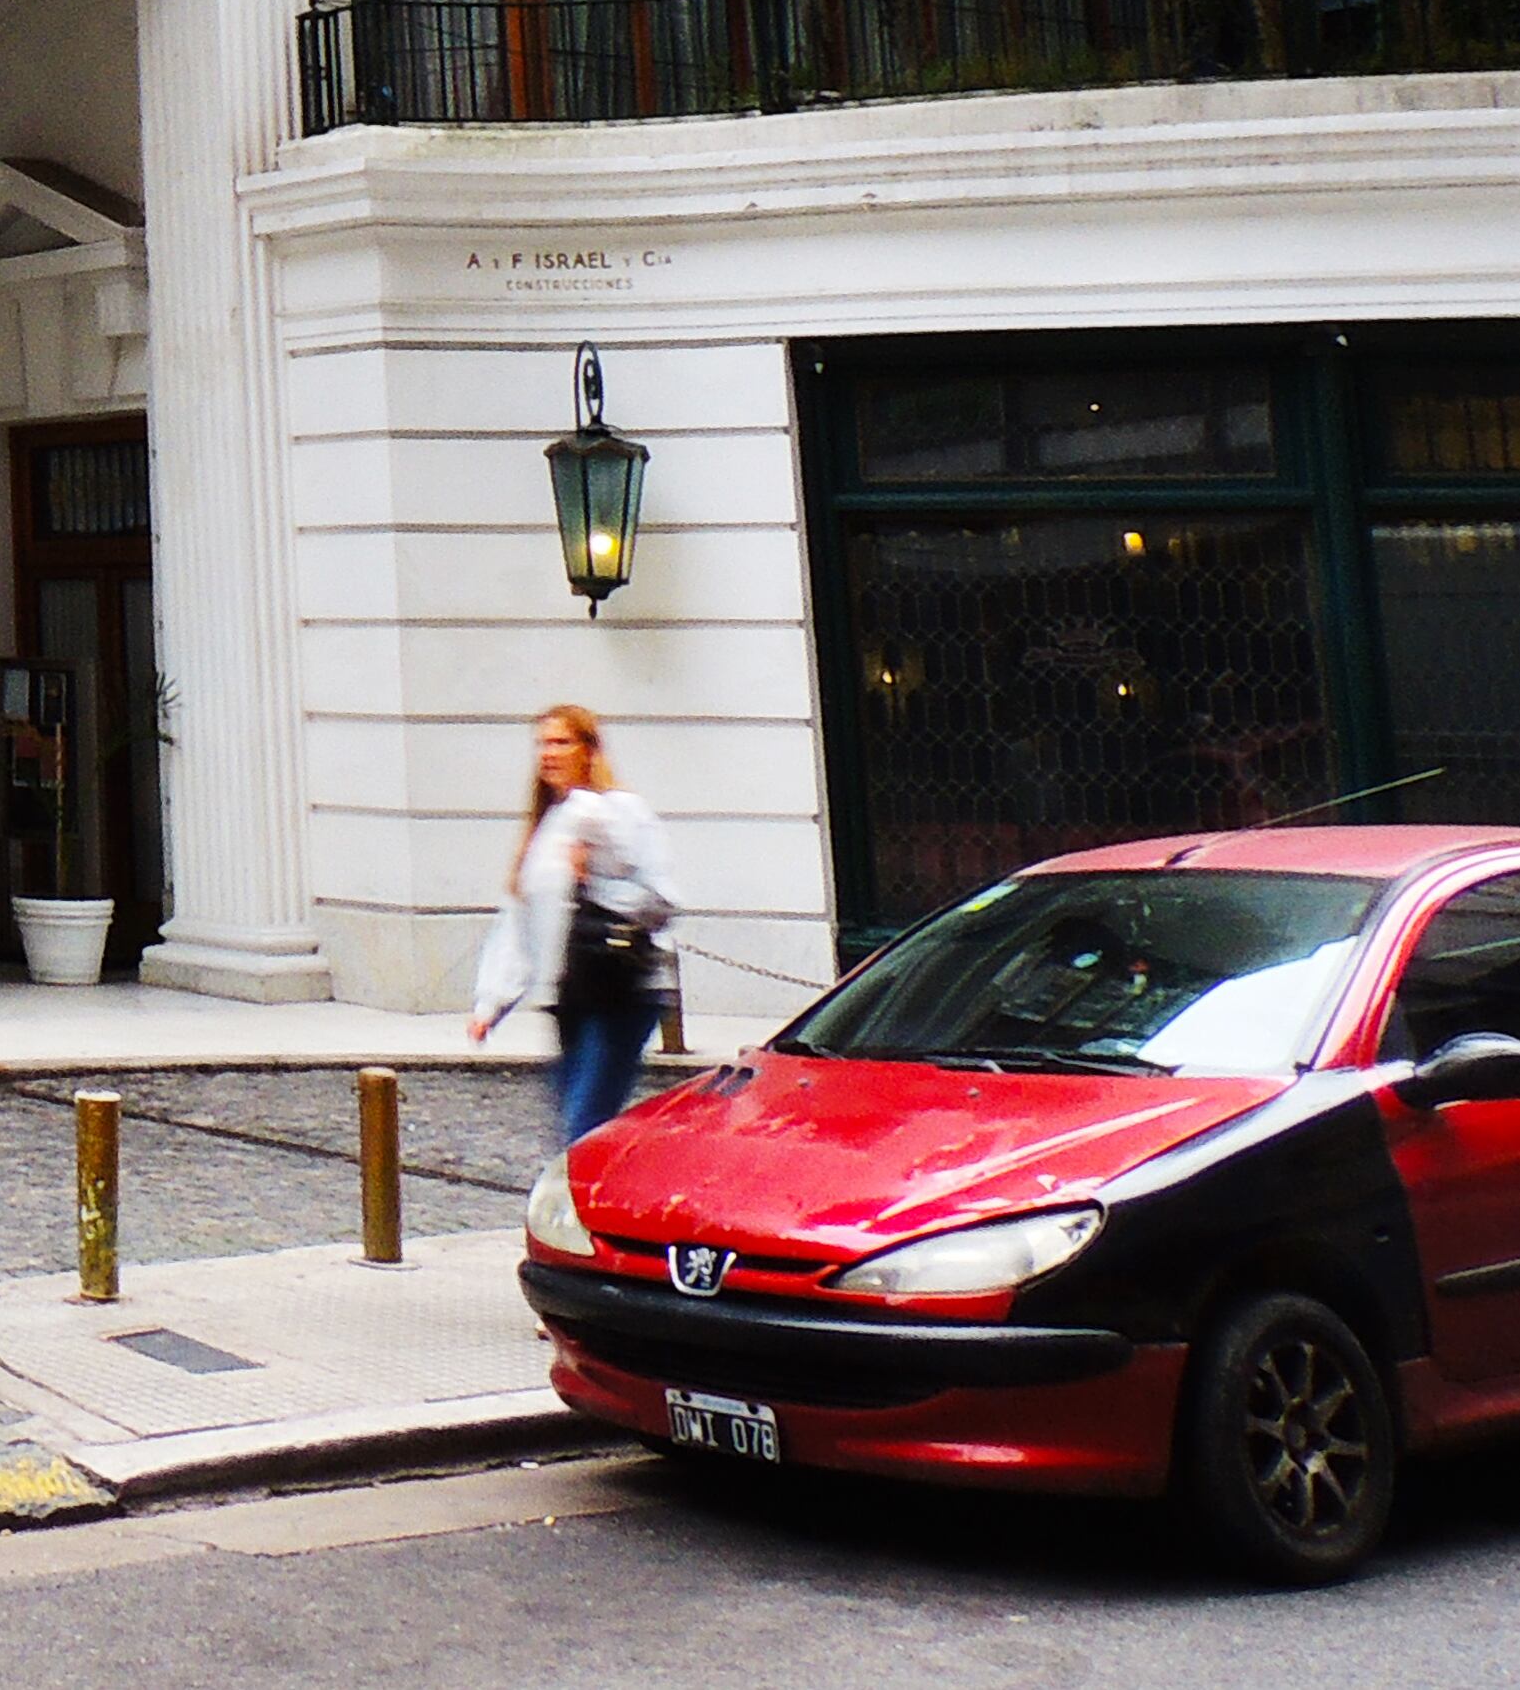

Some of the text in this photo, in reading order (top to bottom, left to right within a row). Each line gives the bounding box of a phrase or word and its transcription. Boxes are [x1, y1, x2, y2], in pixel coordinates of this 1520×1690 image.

[467, 252, 482, 270] A
[511, 252, 524, 270] F
[535, 251, 613, 270] ISRAEL
[506, 276, 634, 291] CONSTRUCCIONES
[731, 1418, 776, 1460] 078
